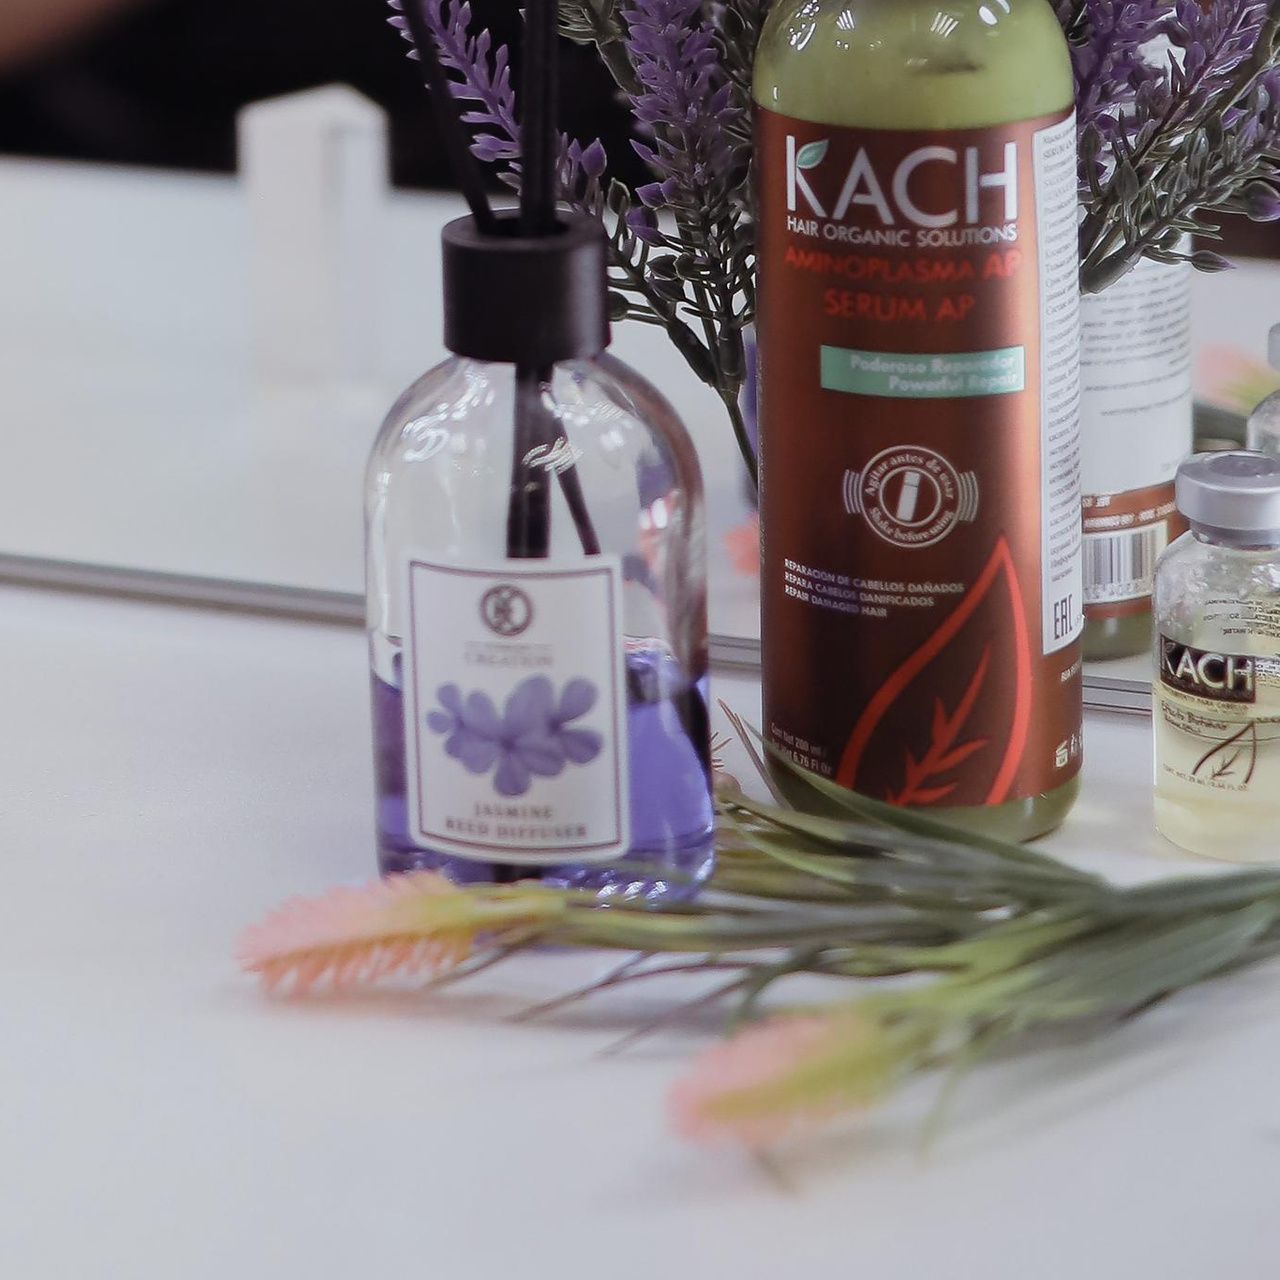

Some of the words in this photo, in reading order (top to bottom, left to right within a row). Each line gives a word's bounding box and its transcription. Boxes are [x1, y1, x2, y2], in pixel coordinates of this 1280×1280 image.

[786, 134, 1018, 228] KACH
[787, 215, 819, 238] HAIR
[823, 223, 910, 247] ORGANIC
[916, 223, 1018, 247] SOLUTIONS
[785, 244, 975, 283] AMINOPLASMA
[824, 288, 927, 321] SERUM
[935, 294, 976, 320] AP
[850, 354, 927, 374] Poderoso
[785, 571, 813, 590] REPARA
[860, 591, 935, 607] DANIFICADOS
[785, 584, 809, 602] REPAIR
[862, 606, 888, 618] HAIR
[853, 578, 906, 592] CABELLOS
[908, 580, 965, 593] DAÑADOS
[1161, 636, 1253, 691] KACH
